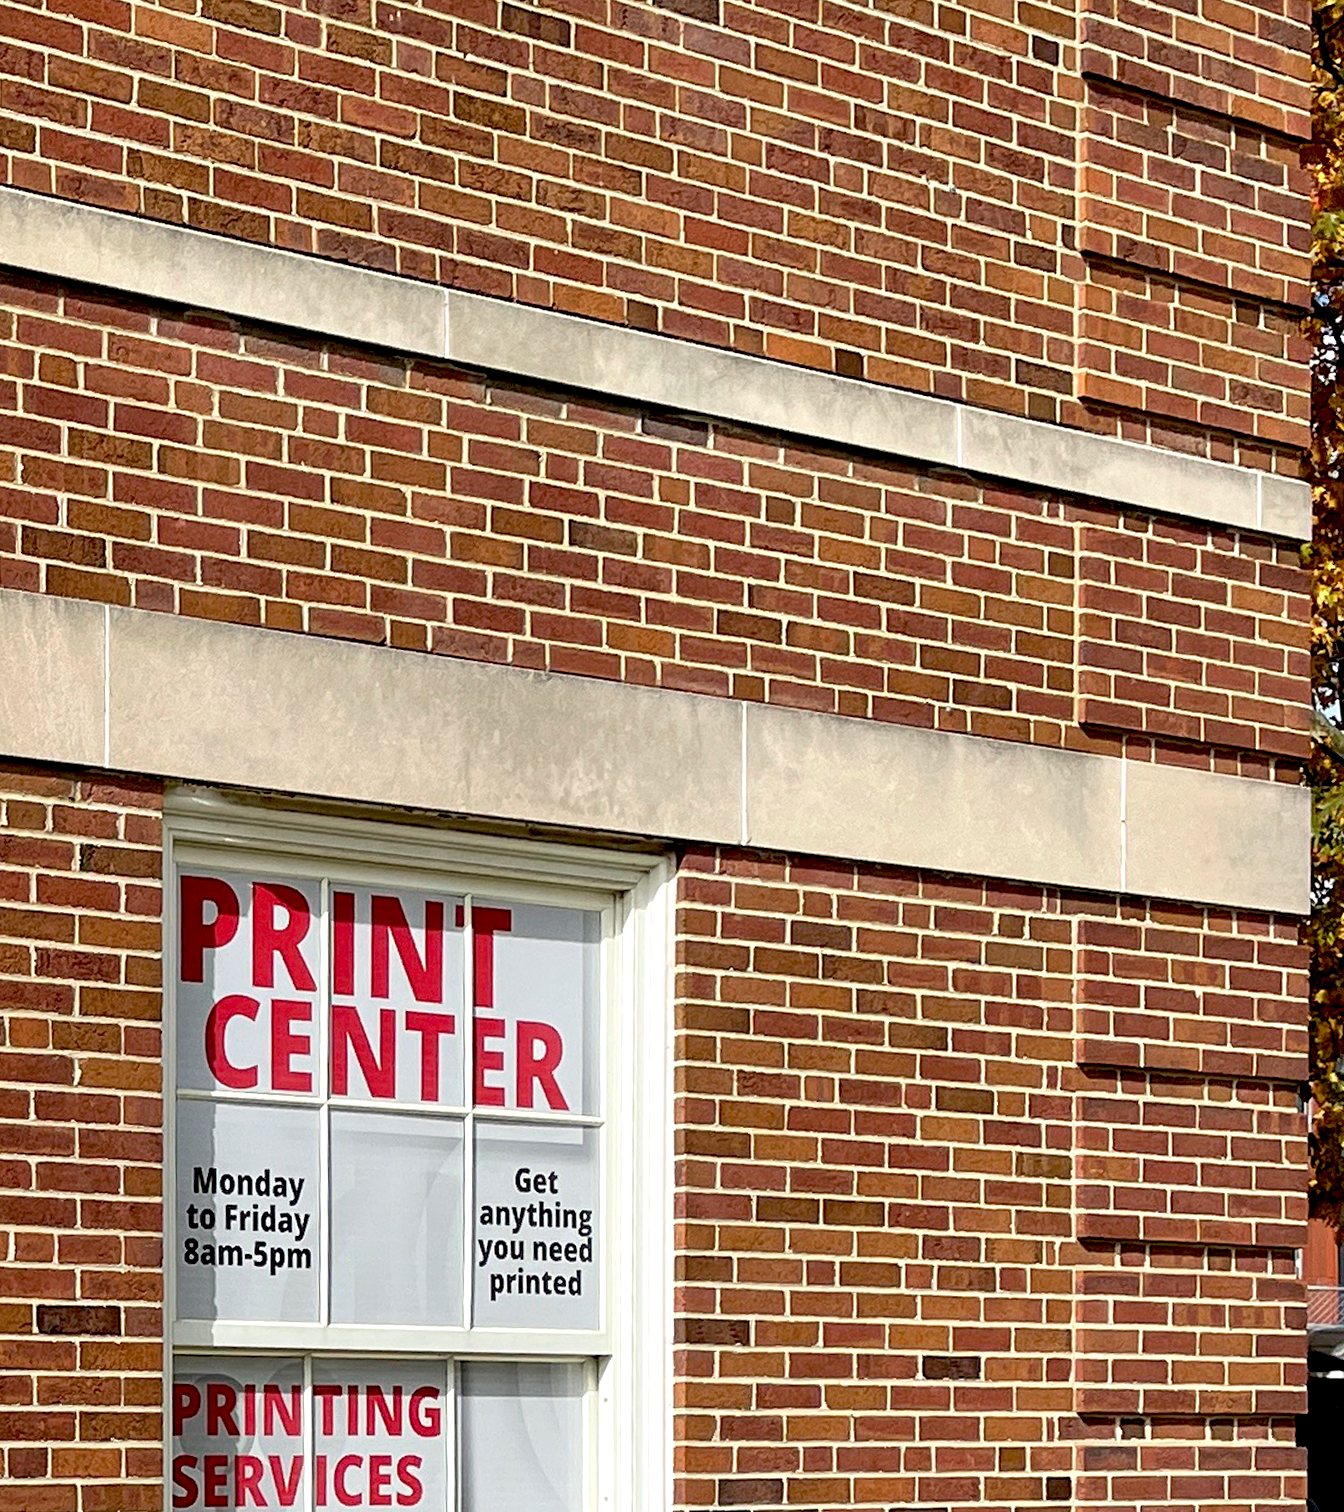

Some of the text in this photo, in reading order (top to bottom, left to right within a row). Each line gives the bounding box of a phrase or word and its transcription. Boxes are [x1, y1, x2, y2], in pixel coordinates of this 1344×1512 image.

[180, 875, 512, 1009] PRINT
[204, 994, 570, 1111] CENTER
[193, 1167, 305, 1205] Monday
[515, 1168, 558, 1194] Get
[187, 1205, 310, 1241] to Friday
[479, 1202, 593, 1237] anything
[183, 1238, 312, 1275] 8am-5pm
[479, 1238, 593, 1267] you need
[490, 1270, 582, 1301] printed
[173, 1383, 441, 1437] PRINTING
[173, 1454, 423, 1508] SERVICES
